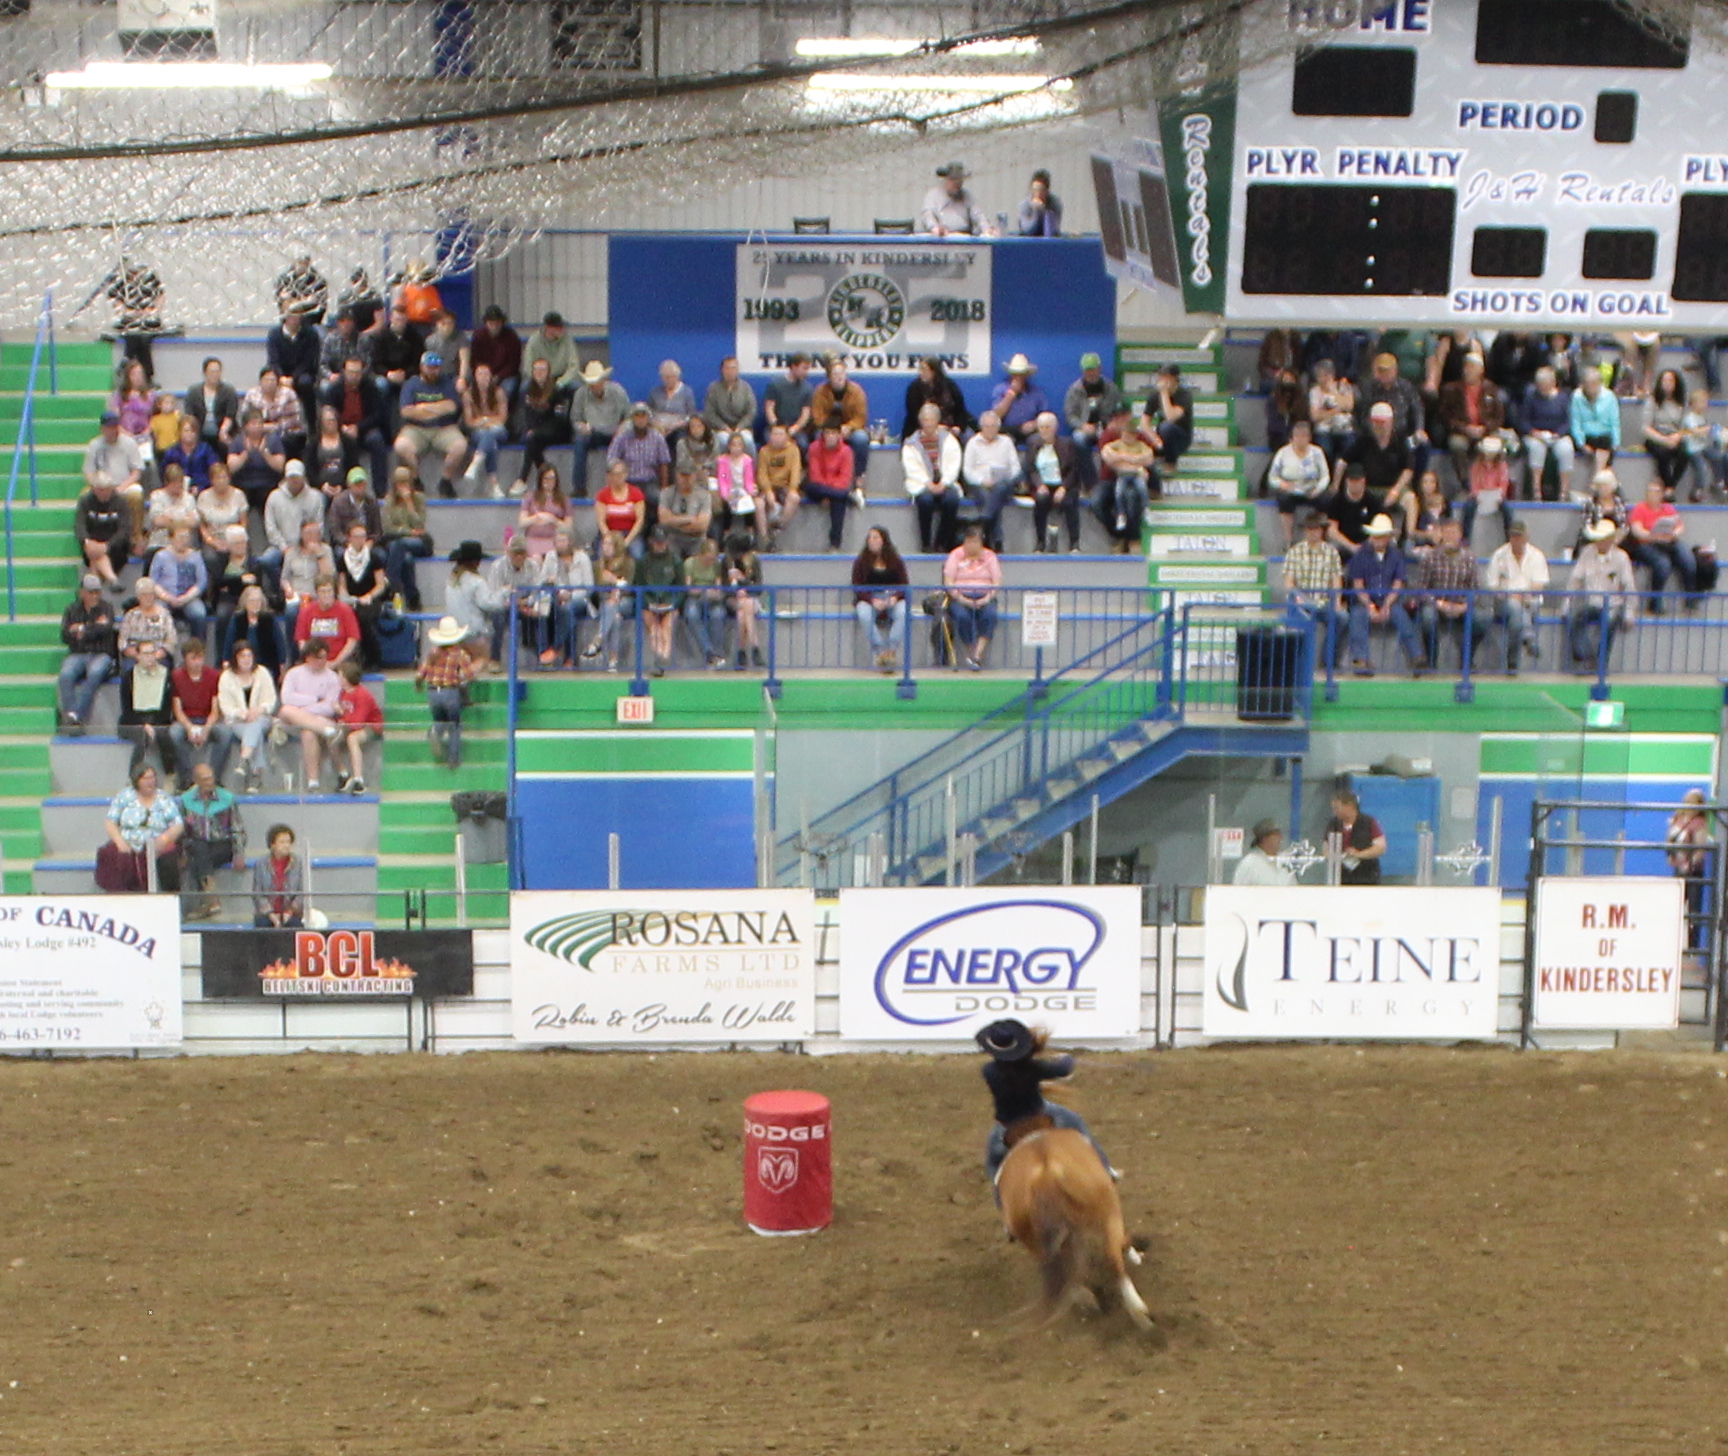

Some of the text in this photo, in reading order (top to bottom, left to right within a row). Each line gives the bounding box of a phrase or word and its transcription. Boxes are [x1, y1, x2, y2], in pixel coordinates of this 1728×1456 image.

[1459, 102, 1583, 131] PERIOD
[1246, 149, 1463, 176] PLYR PENALTY
[1560, 173, 1675, 205] Rentals
[775, 251, 830, 264] YEARS
[835, 251, 855, 264] IN
[743, 298, 985, 322] 1993 2018
[1453, 290, 1669, 317] SHOTS ON GOAL
[852, 353, 906, 369] YOU
[610, 911, 802, 946] ROSANA
[1582, 904, 1637, 930] R.M.
[25, 937, 64, 950] Lodge
[35, 905, 157, 959] CANADA
[295, 930, 381, 979] BCL
[1258, 919, 1482, 984] TEINE
[1598, 939, 1617, 957] OF
[613, 953, 800, 973] FARMS LTD
[904, 948, 1092, 994] ENERGY
[323, 979, 413, 994] CONTRACTING
[704, 976, 799, 991] Agri Business
[1540, 967, 1673, 993] KINDERSLEY
[955, 994, 1096, 1011] DODGE
[1273, 1000, 1474, 1017] ENERGY
[531, 1002, 599, 1030] Robin
[632, 1001, 714, 1033] Brenda
